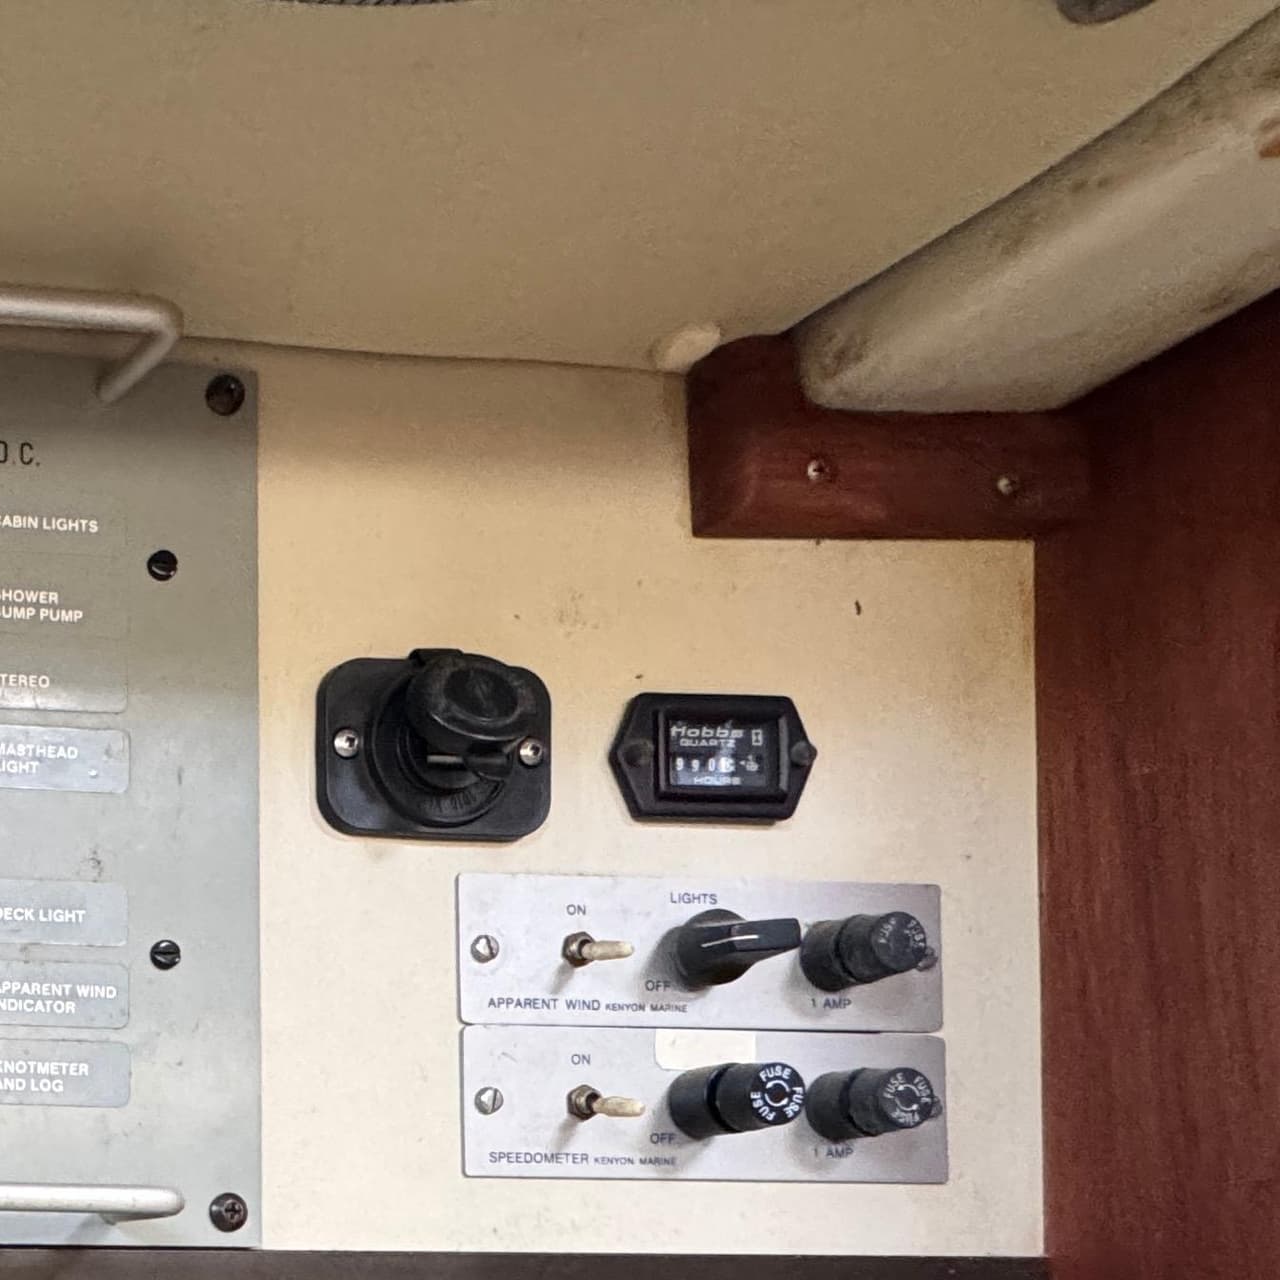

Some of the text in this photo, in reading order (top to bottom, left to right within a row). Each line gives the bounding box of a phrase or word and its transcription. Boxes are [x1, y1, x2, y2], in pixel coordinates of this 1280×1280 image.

[42, 516, 99, 533] LIGHTS
[39, 608, 84, 624] PUMP
[671, 726, 743, 738] Hobbs
[680, 739, 735, 748] QUARTZ
[670, 892, 718, 905] LIGHTS
[38, 909, 86, 924] LIGHT
[566, 904, 587, 916] ON
[76, 983, 117, 999] WIND
[646, 981, 671, 992] OFF
[488, 998, 688, 1013] APPARENT WIND KENYON MARINE
[823, 998, 852, 1008] AMP
[571, 1054, 591, 1066] ON
[759, 1065, 792, 1082] FUSE
[31, 1079, 64, 1093] LOG
[883, 1072, 906, 1099] FUSE
[913, 1075, 932, 1103] FUSE
[751, 1091, 777, 1121] FUSE
[786, 1086, 804, 1118] FUSE
[650, 1133, 676, 1144] OFF
[489, 1152, 676, 1166] SPEEDOMETER KENYON MARINE
[826, 1148, 854, 1158] AMP
